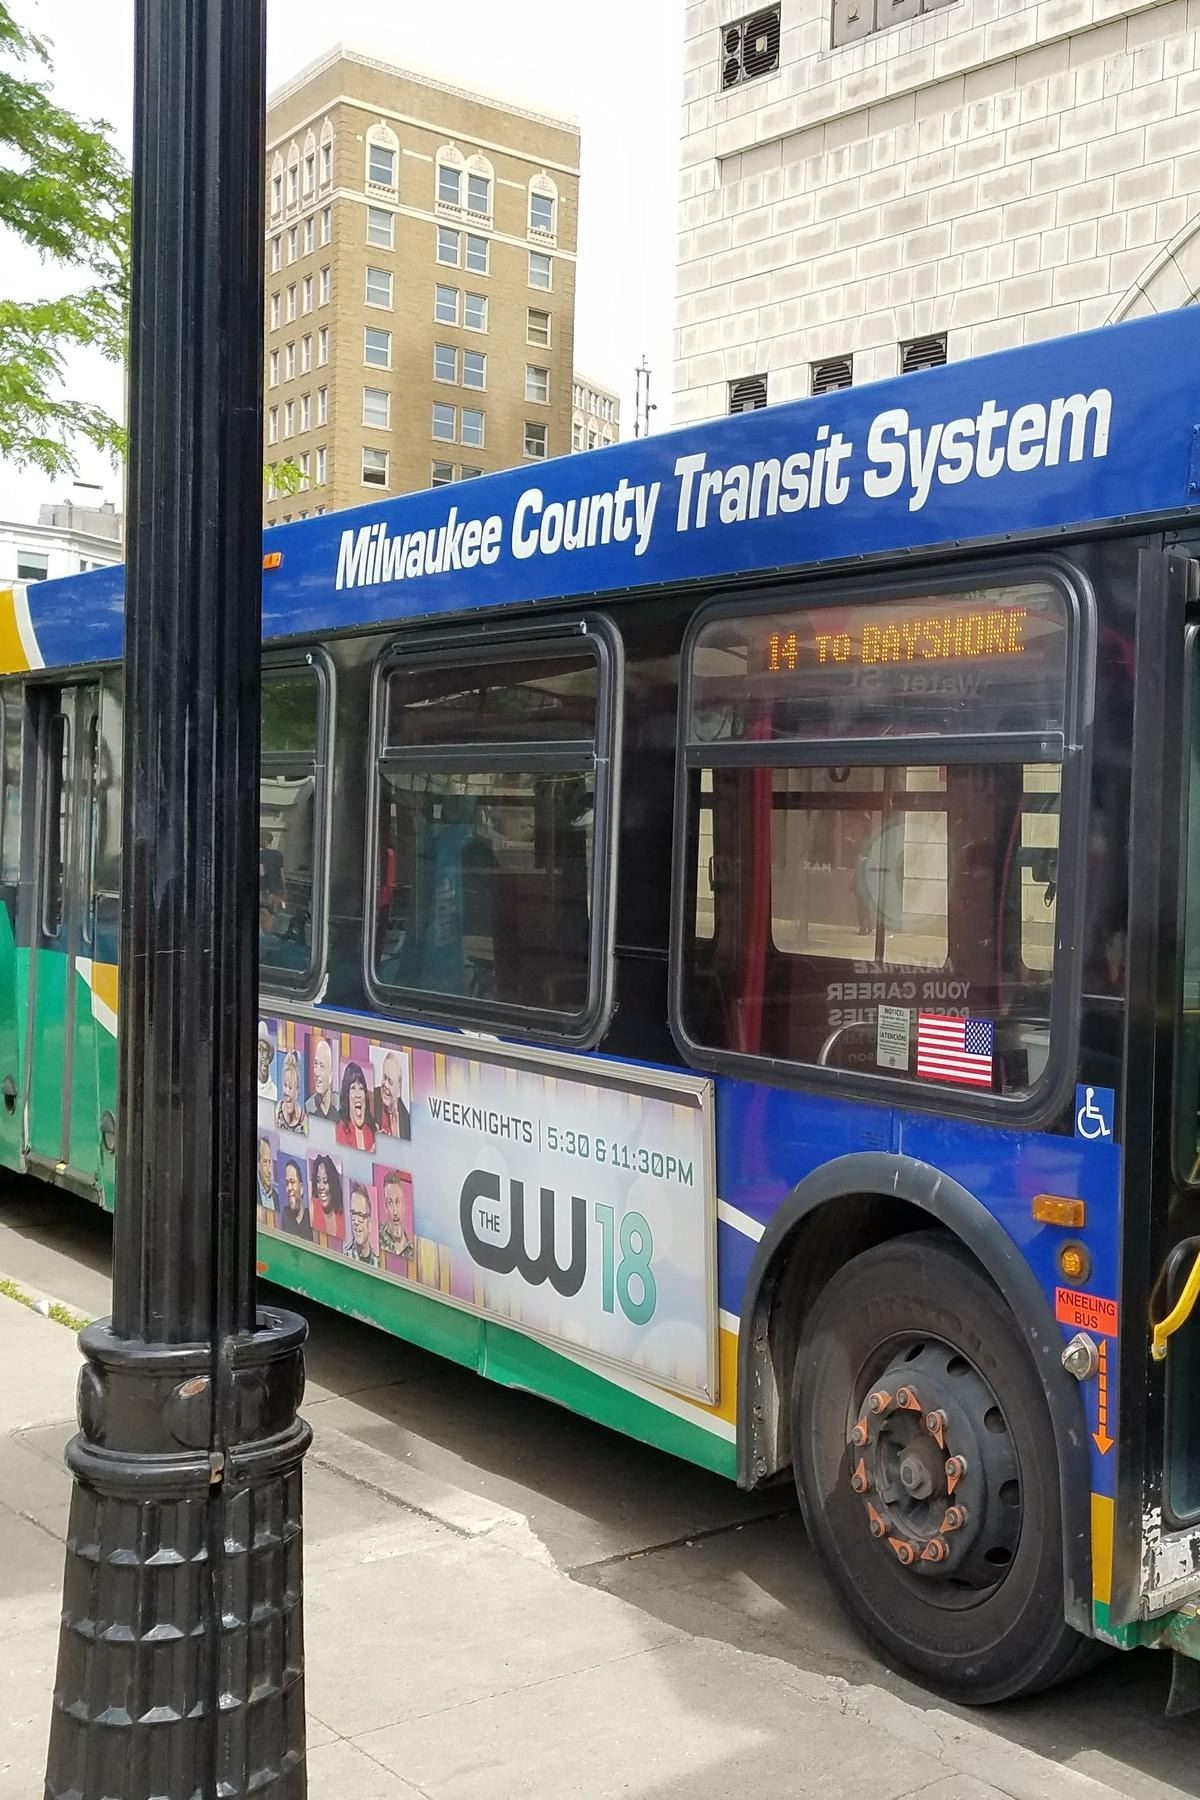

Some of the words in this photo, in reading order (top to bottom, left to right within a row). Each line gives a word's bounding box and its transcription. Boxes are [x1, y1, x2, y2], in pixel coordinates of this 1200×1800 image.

[335, 507, 502, 590] Milwaukee
[511, 478, 662, 557] County
[674, 425, 853, 532] Transit
[863, 388, 1112, 511] System
[768, 631, 798, 671] 14
[816, 634, 850, 663] TO
[862, 608, 1027, 664] BAYSHORE
[428, 1096, 533, 1143] WEEKNIGHTS
[547, 1126, 589, 1158] 5:30
[595, 1138, 606, 1162] &
[611, 1142, 694, 1186] 11:30PM
[459, 1169, 587, 1298] CW
[479, 1209, 501, 1233] THE
[594, 1202, 658, 1326] 18
[1058, 1290, 1116, 1318] KNEELING
[1074, 1311, 1098, 1329] BUS
